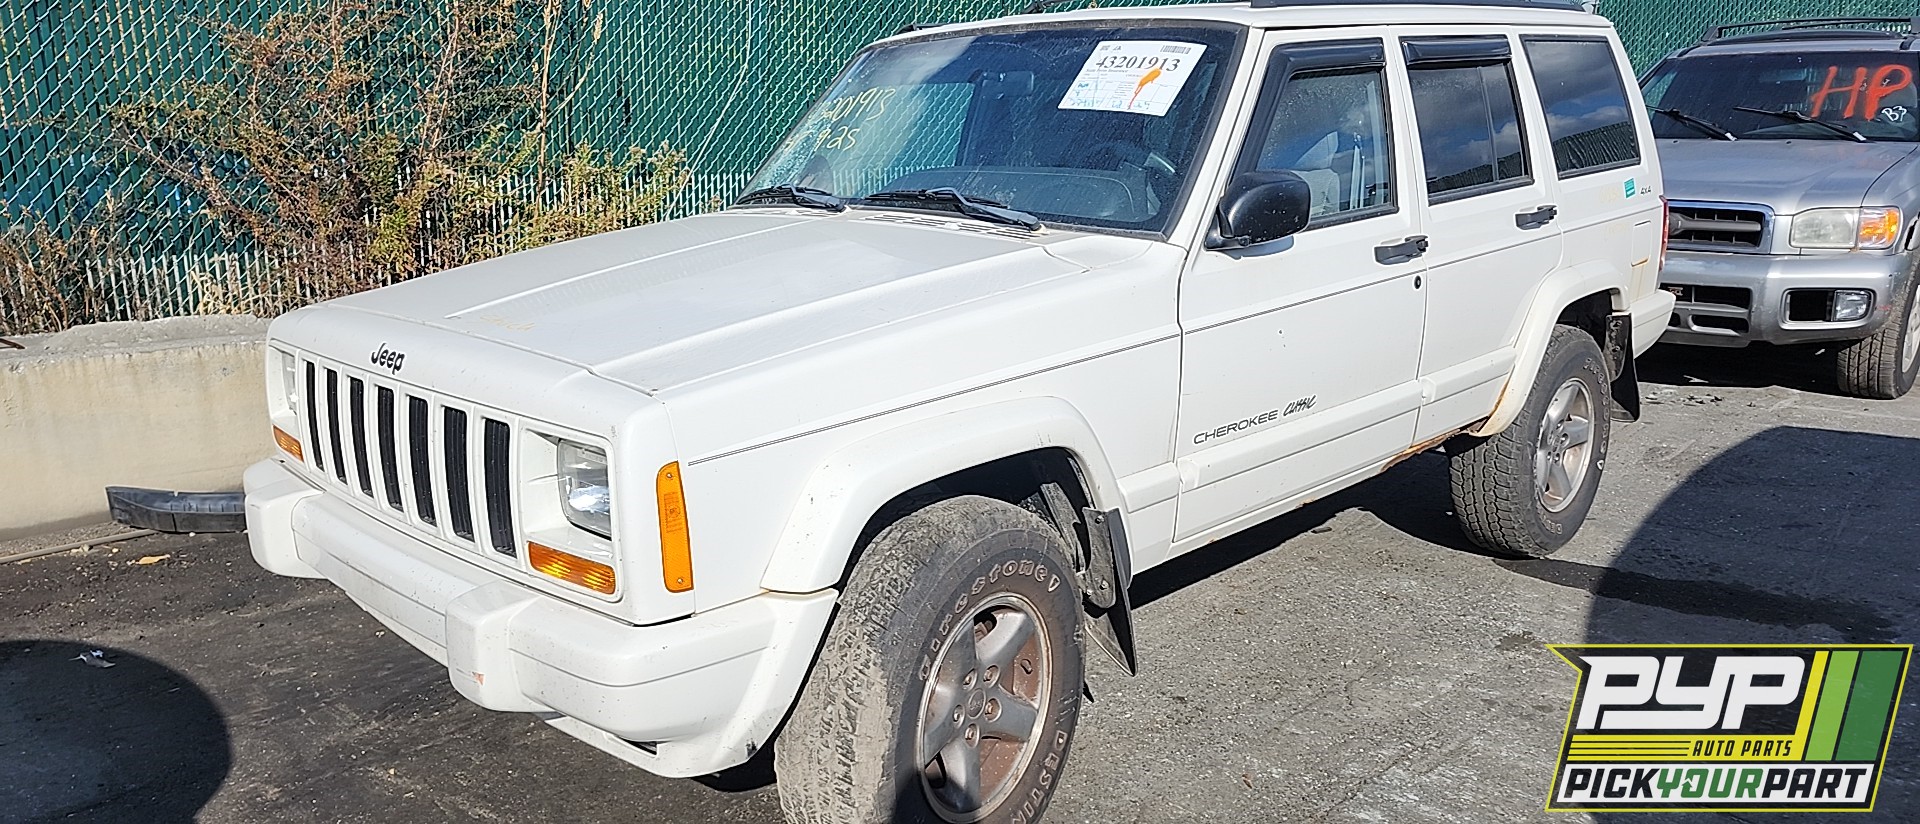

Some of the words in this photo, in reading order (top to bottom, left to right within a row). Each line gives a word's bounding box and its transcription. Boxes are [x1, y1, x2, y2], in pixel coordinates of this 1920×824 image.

[1096, 55, 1181, 72] 43201913
[1810, 64, 1912, 121] HP
[371, 342, 405, 375] Jeep
[1193, 409, 1278, 445] CHEROKEE
